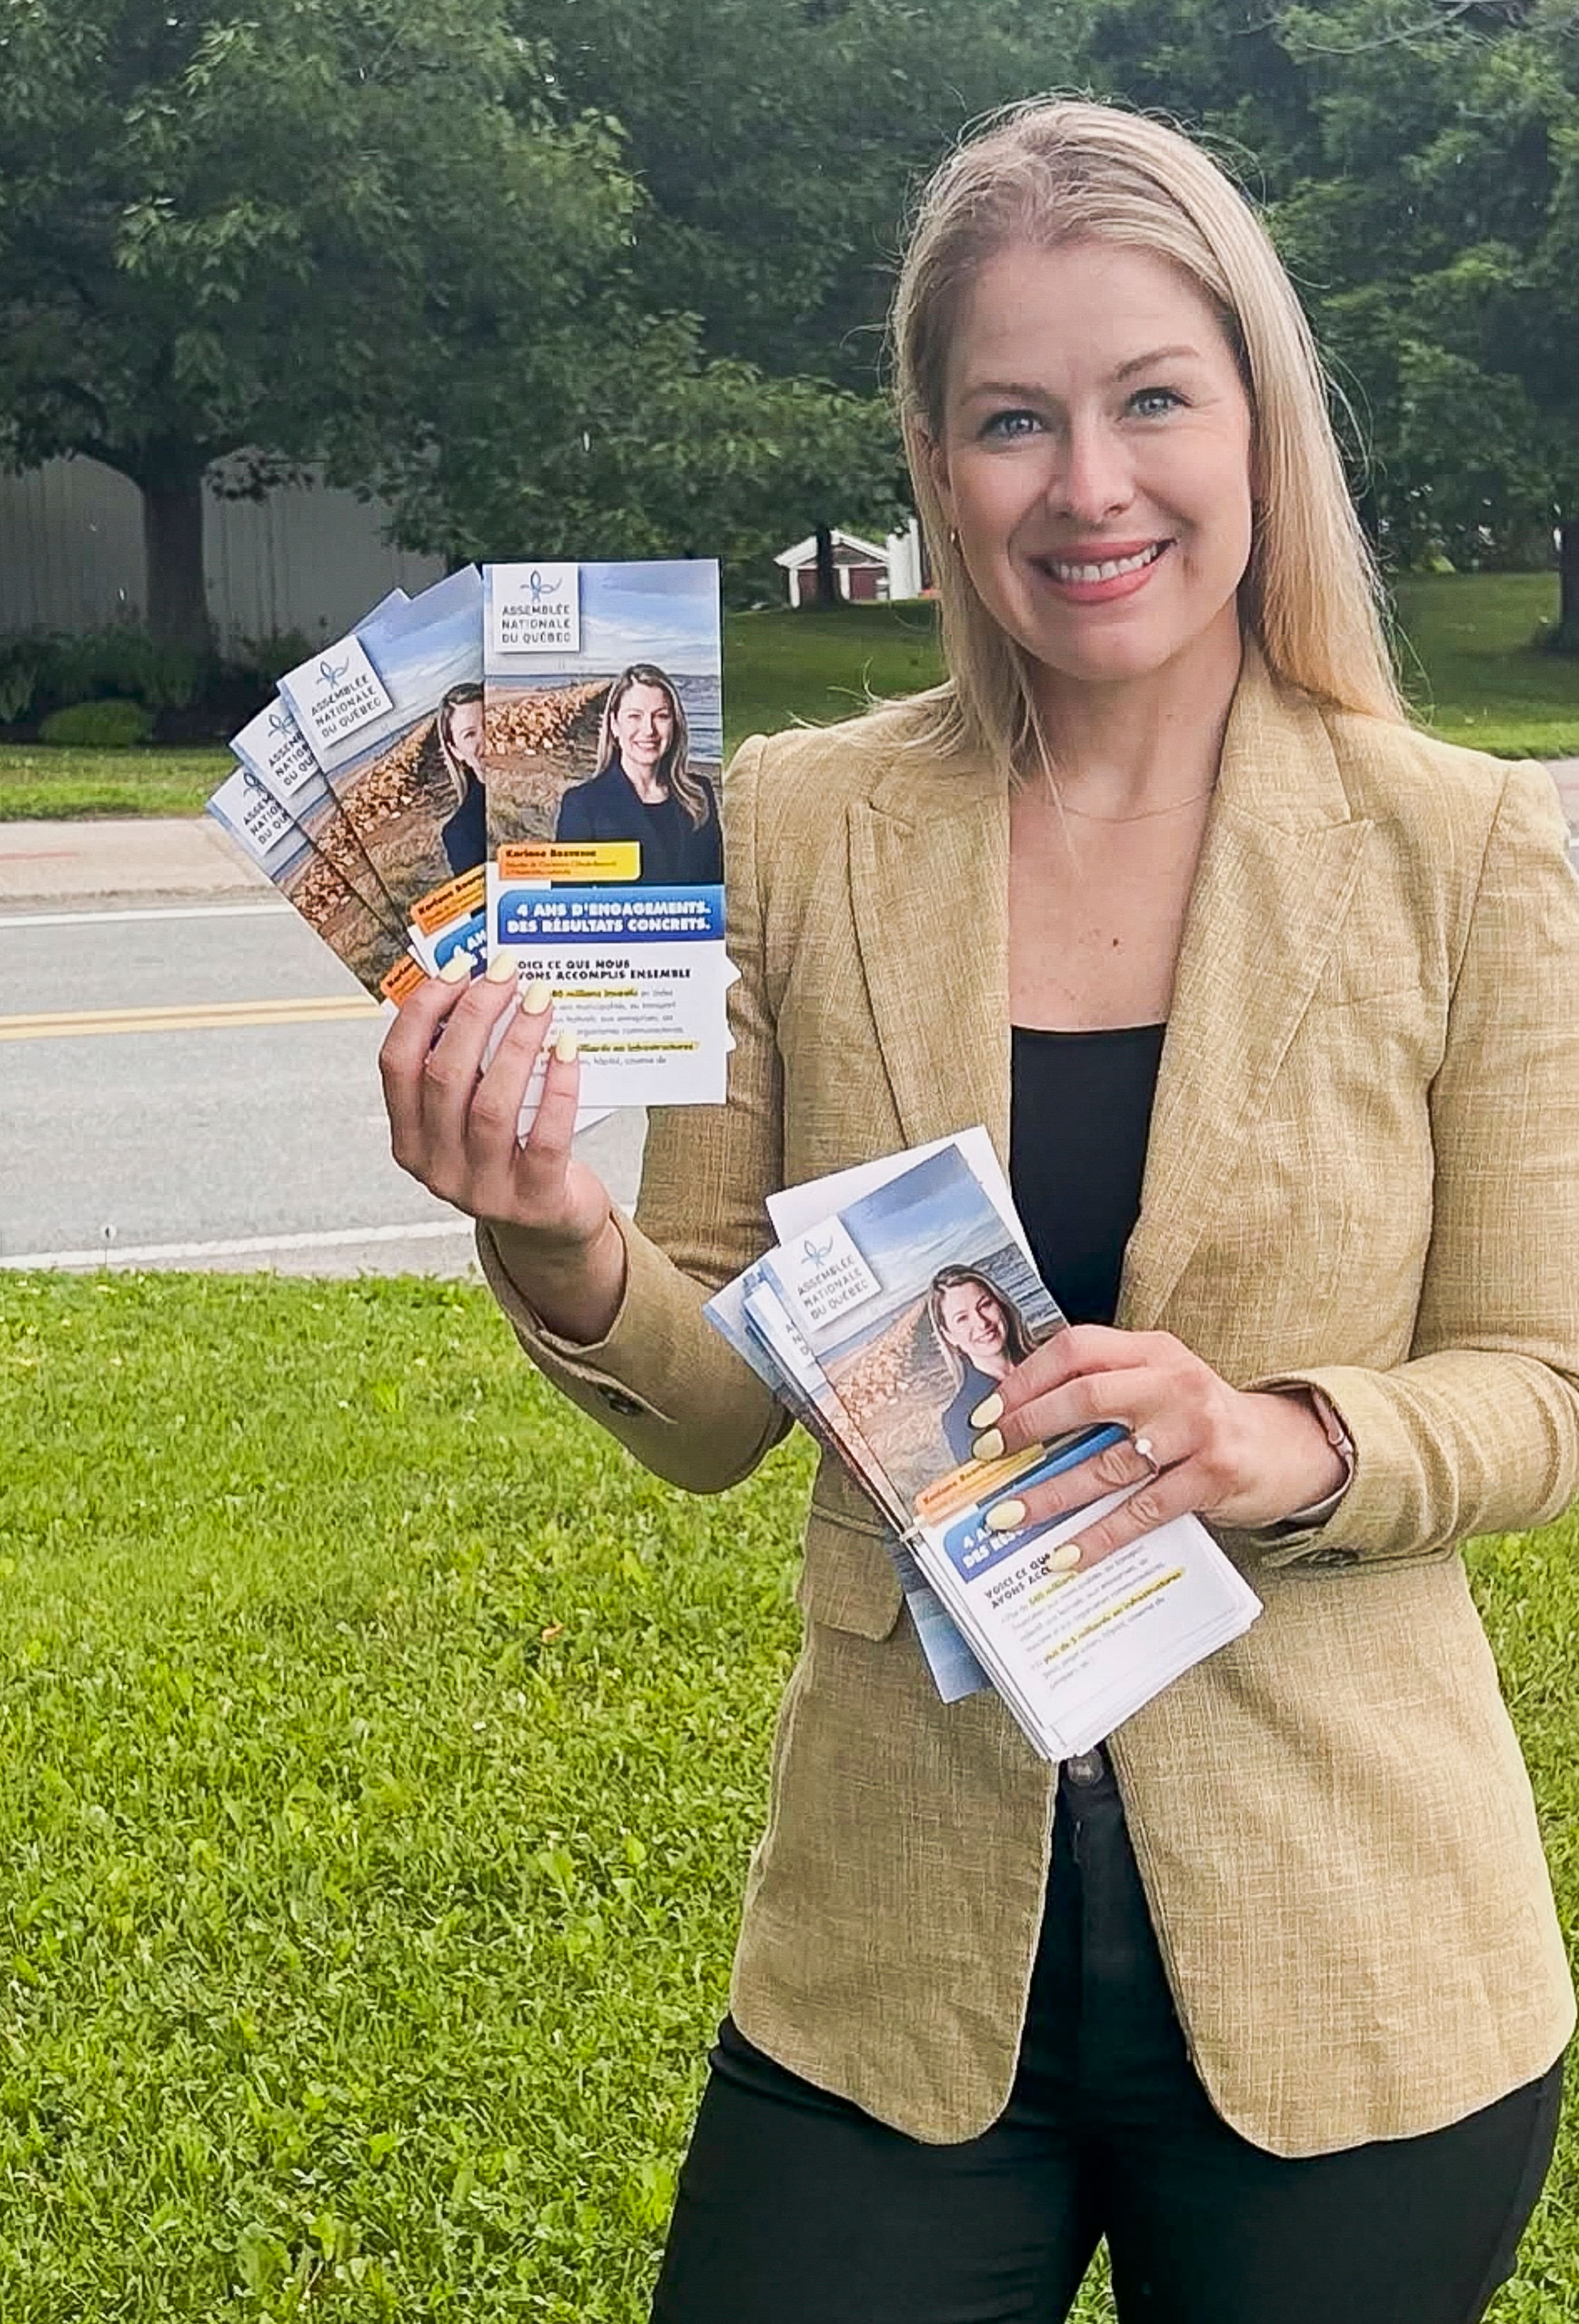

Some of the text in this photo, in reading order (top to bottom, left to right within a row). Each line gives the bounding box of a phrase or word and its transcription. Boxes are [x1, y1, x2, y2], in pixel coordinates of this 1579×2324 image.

[502, 603, 571, 615] ASSEMBLÉE
[502, 619, 571, 629] NATIONALE
[502, 632, 571, 645] DU QUÉBEC
[316, 686, 376, 726] NATIONALE
[322, 722, 337, 738] DU
[283, 756, 313, 786] DU QU
[258, 812, 288, 845] DU QU
[516, 901, 712, 917] 4 ANS D'ENGAGEMENTS.
[507, 916, 711, 933] DES RÉSULTATS CONCRETS.
[518, 959, 630, 970] OICI CE QUE NOUS
[556, 970, 626, 980] ACCOMPLIS
[631, 968, 691, 979] ENSEMBLE
[803, 1268, 862, 1308] NATIONALE
[811, 1304, 827, 1319] DU
[963, 1535, 974, 1549] 4
[962, 1544, 989, 1569] DES
[984, 1576, 1013, 1598] VOICI
[1015, 1567, 1027, 1580] CE
[991, 1582, 1025, 1609] AVONS
